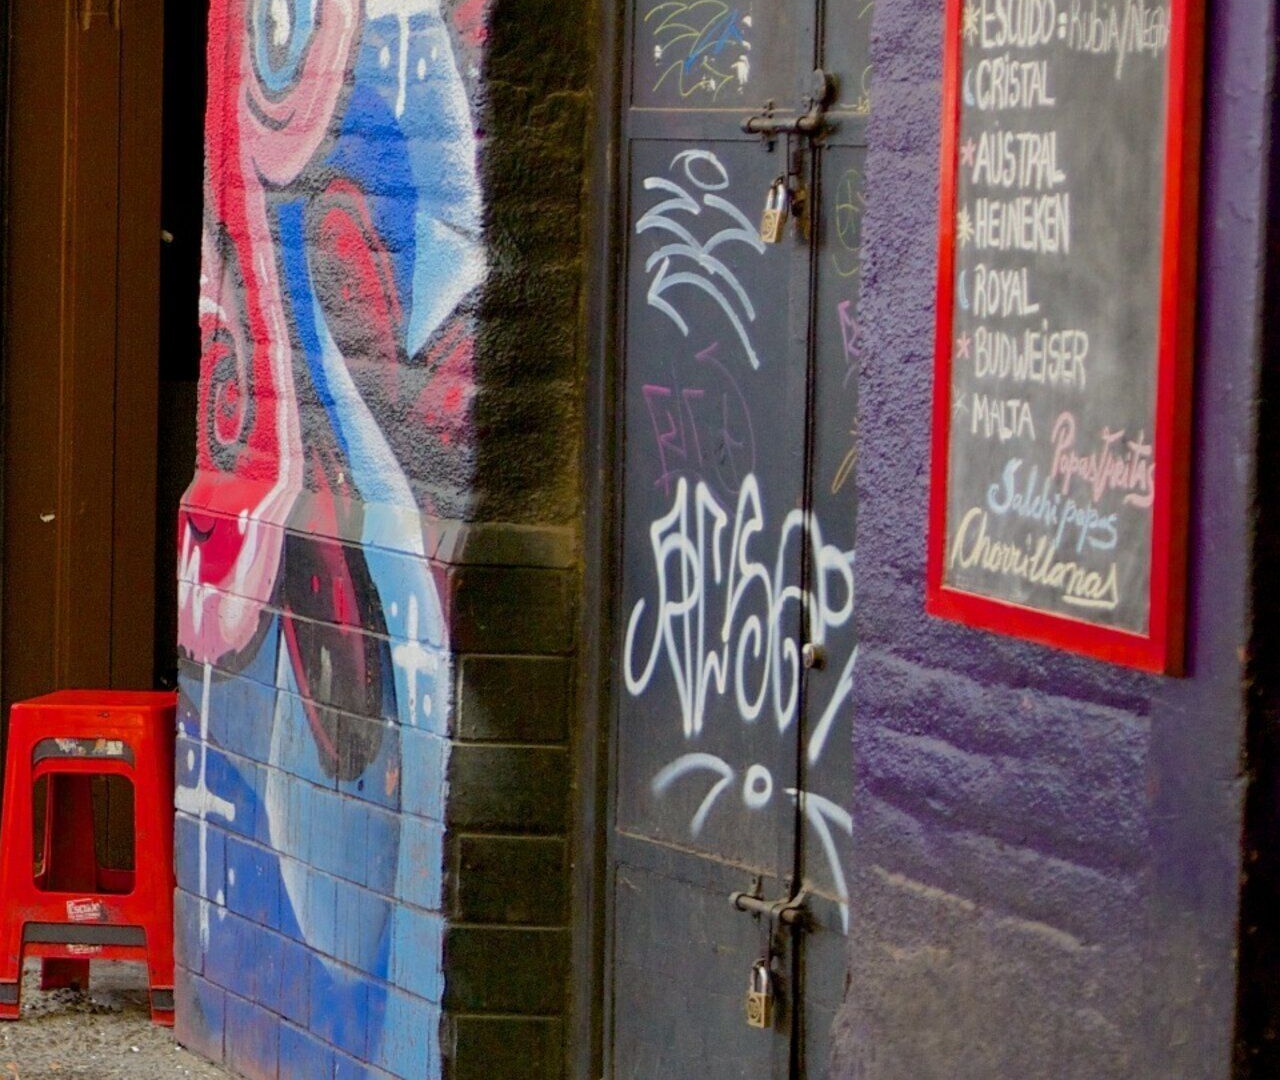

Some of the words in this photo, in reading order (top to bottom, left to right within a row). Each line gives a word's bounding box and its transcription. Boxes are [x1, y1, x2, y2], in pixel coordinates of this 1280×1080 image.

[975, 54, 1056, 110] CRISTAL
[972, 131, 1066, 190] AUSTRAL
[975, 193, 1070, 254] HEINEKEN
[973, 263, 1040, 319] ROYAL
[975, 320, 1088, 390] BUDWEISER
[971, 392, 1036, 442] MALTA
